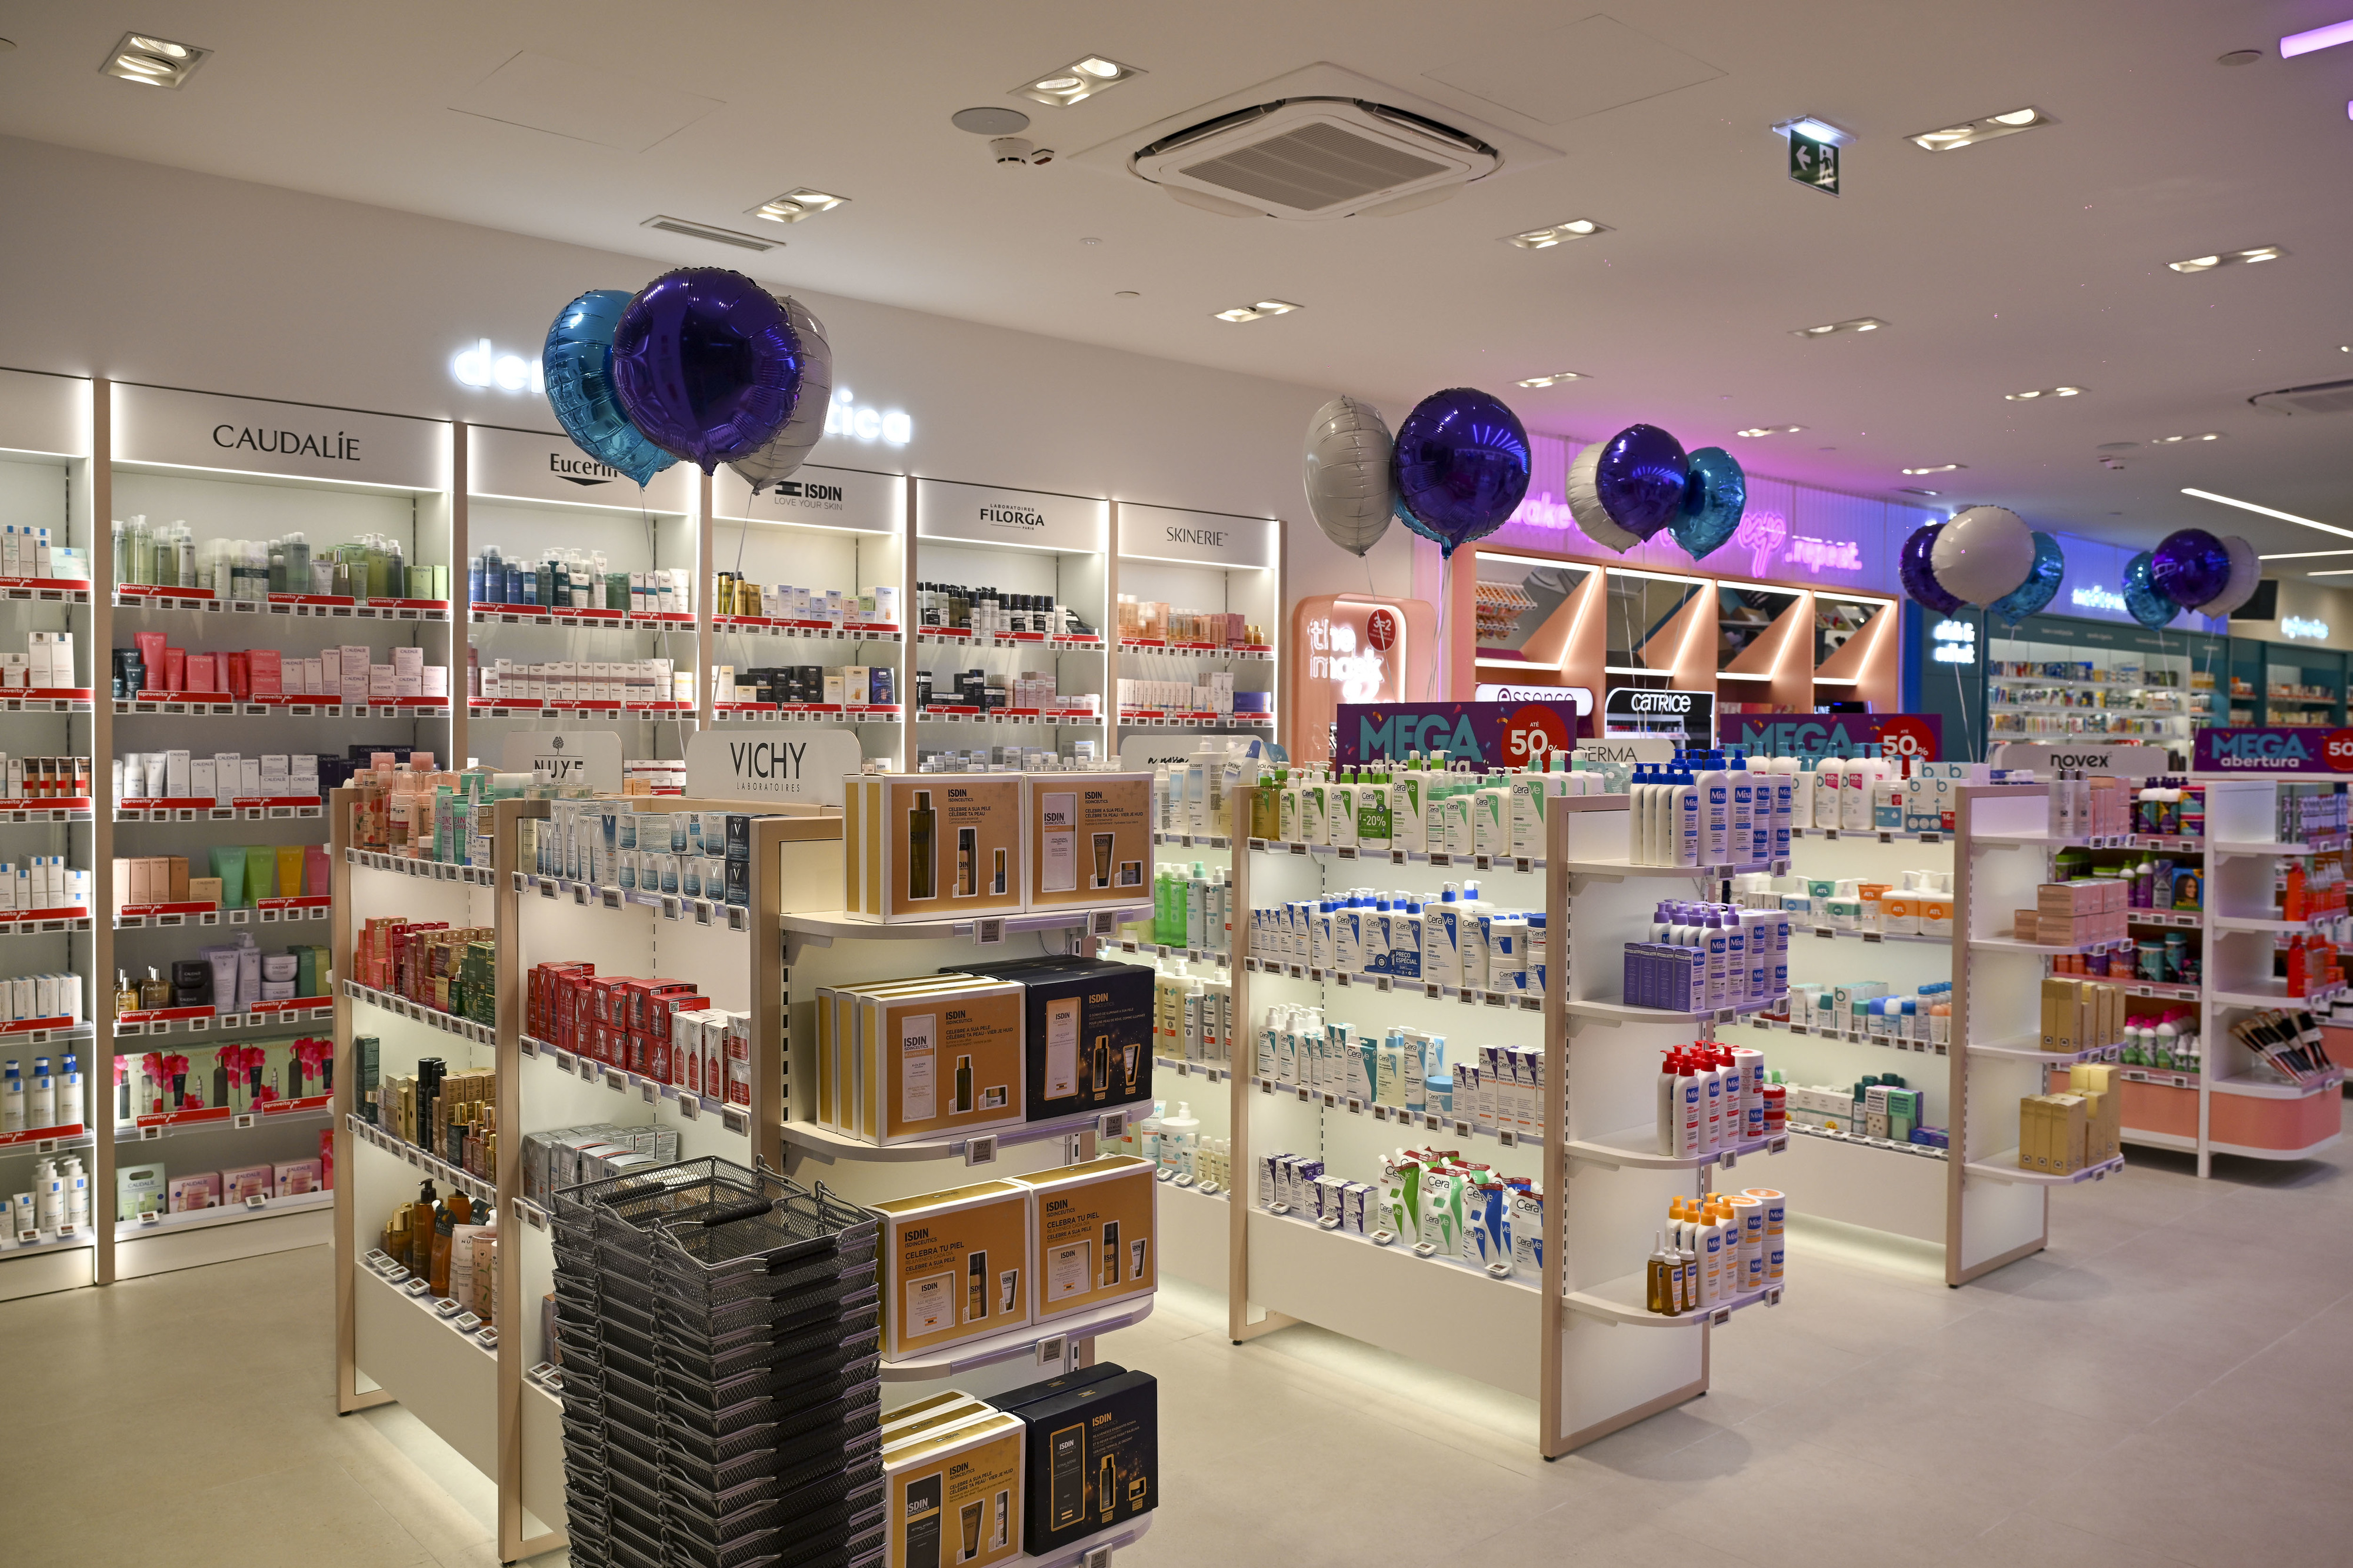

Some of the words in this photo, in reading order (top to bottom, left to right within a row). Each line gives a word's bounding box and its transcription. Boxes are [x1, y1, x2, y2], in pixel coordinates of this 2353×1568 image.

[805, 483, 842, 502] ISDIN
[775, 497, 796, 506] LOVE
[799, 499, 821, 509] YOUR
[824, 501, 842, 511] SKIN
[990, 503, 1035, 512] LABORATOIRES
[980, 508, 1045, 526] FILORGA
[1360, 714, 1483, 762] MEGA
[1741, 722, 1854, 758] MEGA
[1883, 735, 1929, 756] 50%
[2211, 733, 2309, 759] MEGA
[730, 742, 806, 779] VICHY
[1371, 753, 1470, 774] abetra
[2050, 752, 2109, 769] novex
[2220, 755, 2299, 768] abertura
[737, 782, 801, 792] LABORATOIRES
[1393, 781, 1416, 793] CeraVe
[1512, 782, 1541, 796] CeraVe
[1331, 791, 1349, 801] CeraVe
[1362, 792, 1383, 801] CeraVe
[1711, 791, 1726, 799] Mixa
[1476, 797, 1496, 808] CeraVe
[1044, 813, 1064, 822] ISDIN
[1362, 815, 1387, 828] -20%
[1367, 919, 1388, 928] CeraVe
[1427, 914, 1454, 925] CeraVe
[1463, 920, 1488, 928] CeraVe
[1396, 922, 1418, 931] CeraVe
[1712, 940, 1725, 949] Mixa
[1396, 951, 1411, 959] PREÇO
[1694, 955, 1704, 963] Mixa
[1089, 993, 1108, 1003] ISDIN
[946, 1010, 965, 1020] ISDIN
[904, 1036, 926, 1047] ISDIN
[1404, 1042, 1425, 1052] CeraVe
[1347, 1049, 1369, 1060] CeraVe
[1479, 1058, 1497, 1066] CeraVe
[1687, 1089, 1699, 1099] Mixa
[1046, 1199, 1068, 1212] ISDIN
[1379, 1203, 1401, 1216] CeraVe
[1046, 1207, 1075, 1217] ISDINCEUTICS
[1770, 1209, 1784, 1219] Mixa
[1047, 1217, 1076, 1229] CELEBRA
[1087, 1212, 1099, 1220] PIEL
[1425, 1213, 1449, 1226] CeraVe
[905, 1228, 929, 1242] ISDIN
[905, 1237, 937, 1248] ISDINCEUTICS
[1516, 1235, 1541, 1250] CeraVe
[1708, 1237, 1720, 1249] Mixa
[905, 1247, 938, 1260] CELEBRA
[950, 1242, 964, 1250] PIEL
[1061, 1250, 1075, 1259] ISDIN
[905, 1263, 928, 1272] CELEBRE
[921, 1282, 938, 1292] ISDIN
[1092, 1412, 1112, 1427] ISDIN
[1059, 1440, 1074, 1450] ISDIN
[949, 1462, 969, 1475] ISDIN
[950, 1468, 975, 1480] ISDINCEUTICS
[949, 1480, 968, 1490] CELEBRE
[975, 1479, 986, 1487] PEAU
